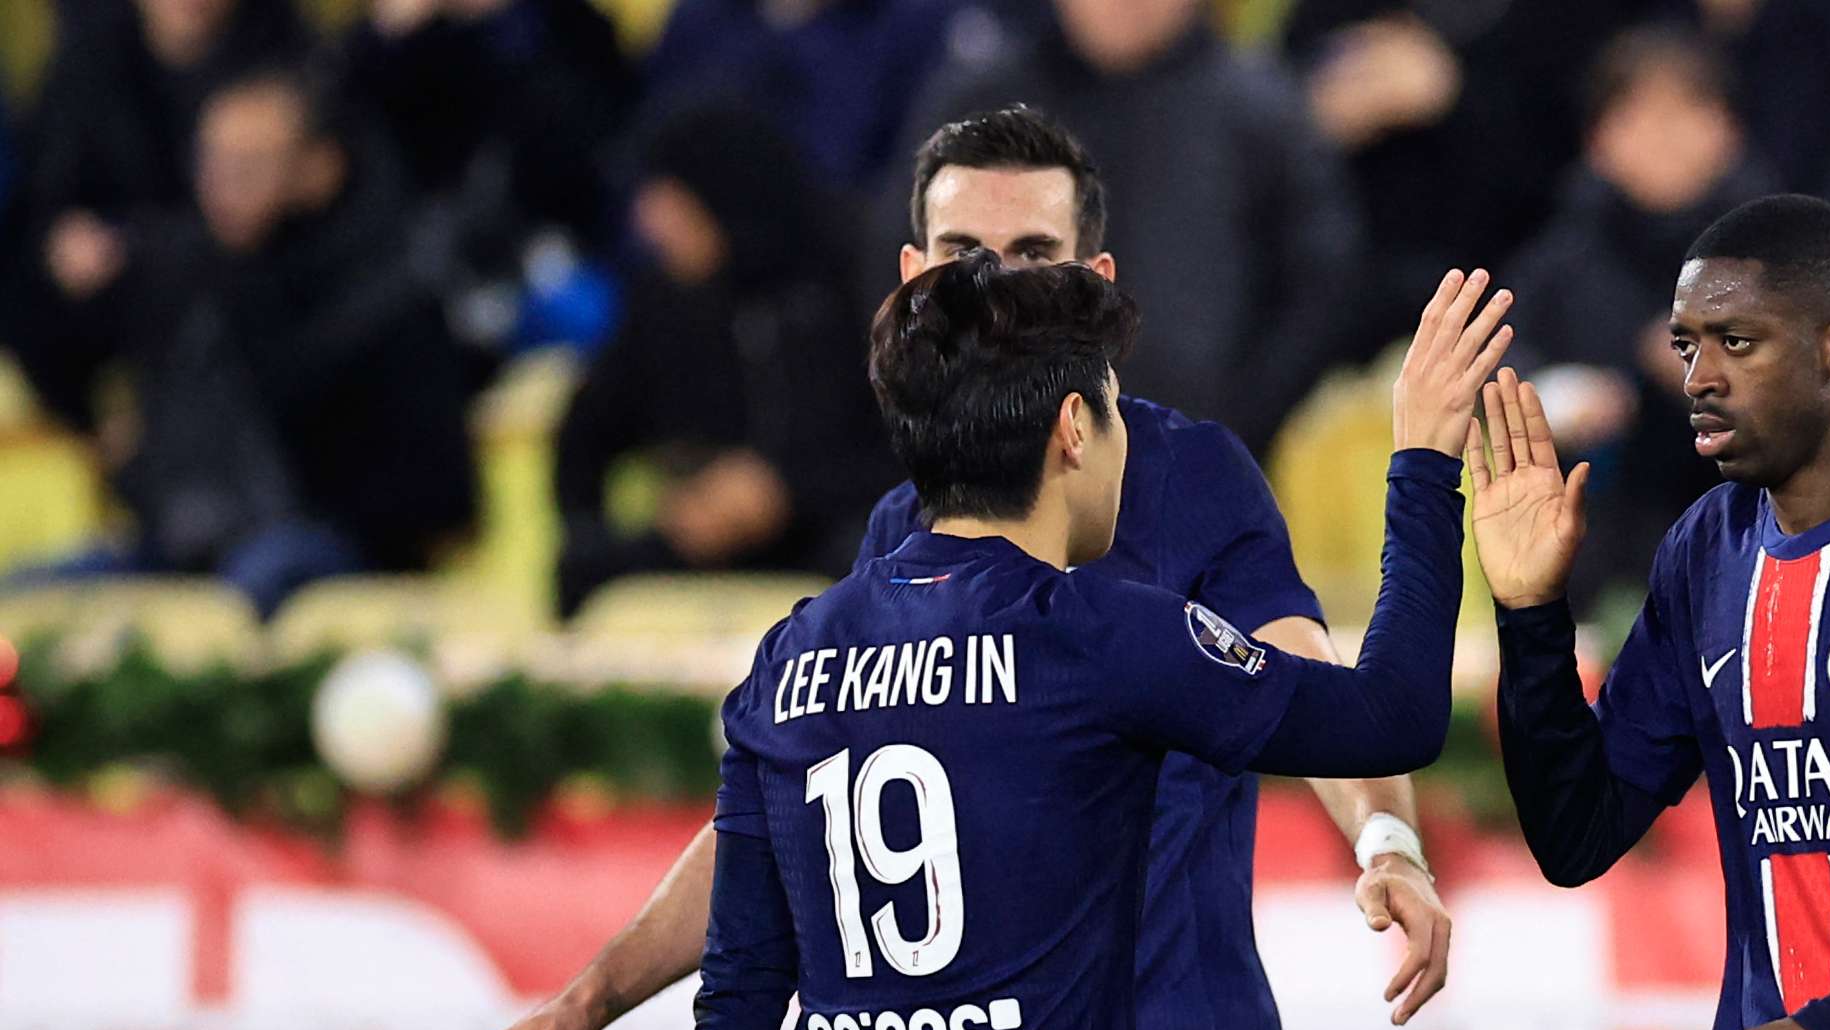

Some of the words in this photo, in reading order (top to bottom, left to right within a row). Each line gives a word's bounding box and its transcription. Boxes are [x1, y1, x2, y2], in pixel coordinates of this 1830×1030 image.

[774, 648, 838, 724] LEE
[836, 635, 954, 712] KANG
[965, 634, 1017, 704] IN
[805, 744, 964, 978] 19
